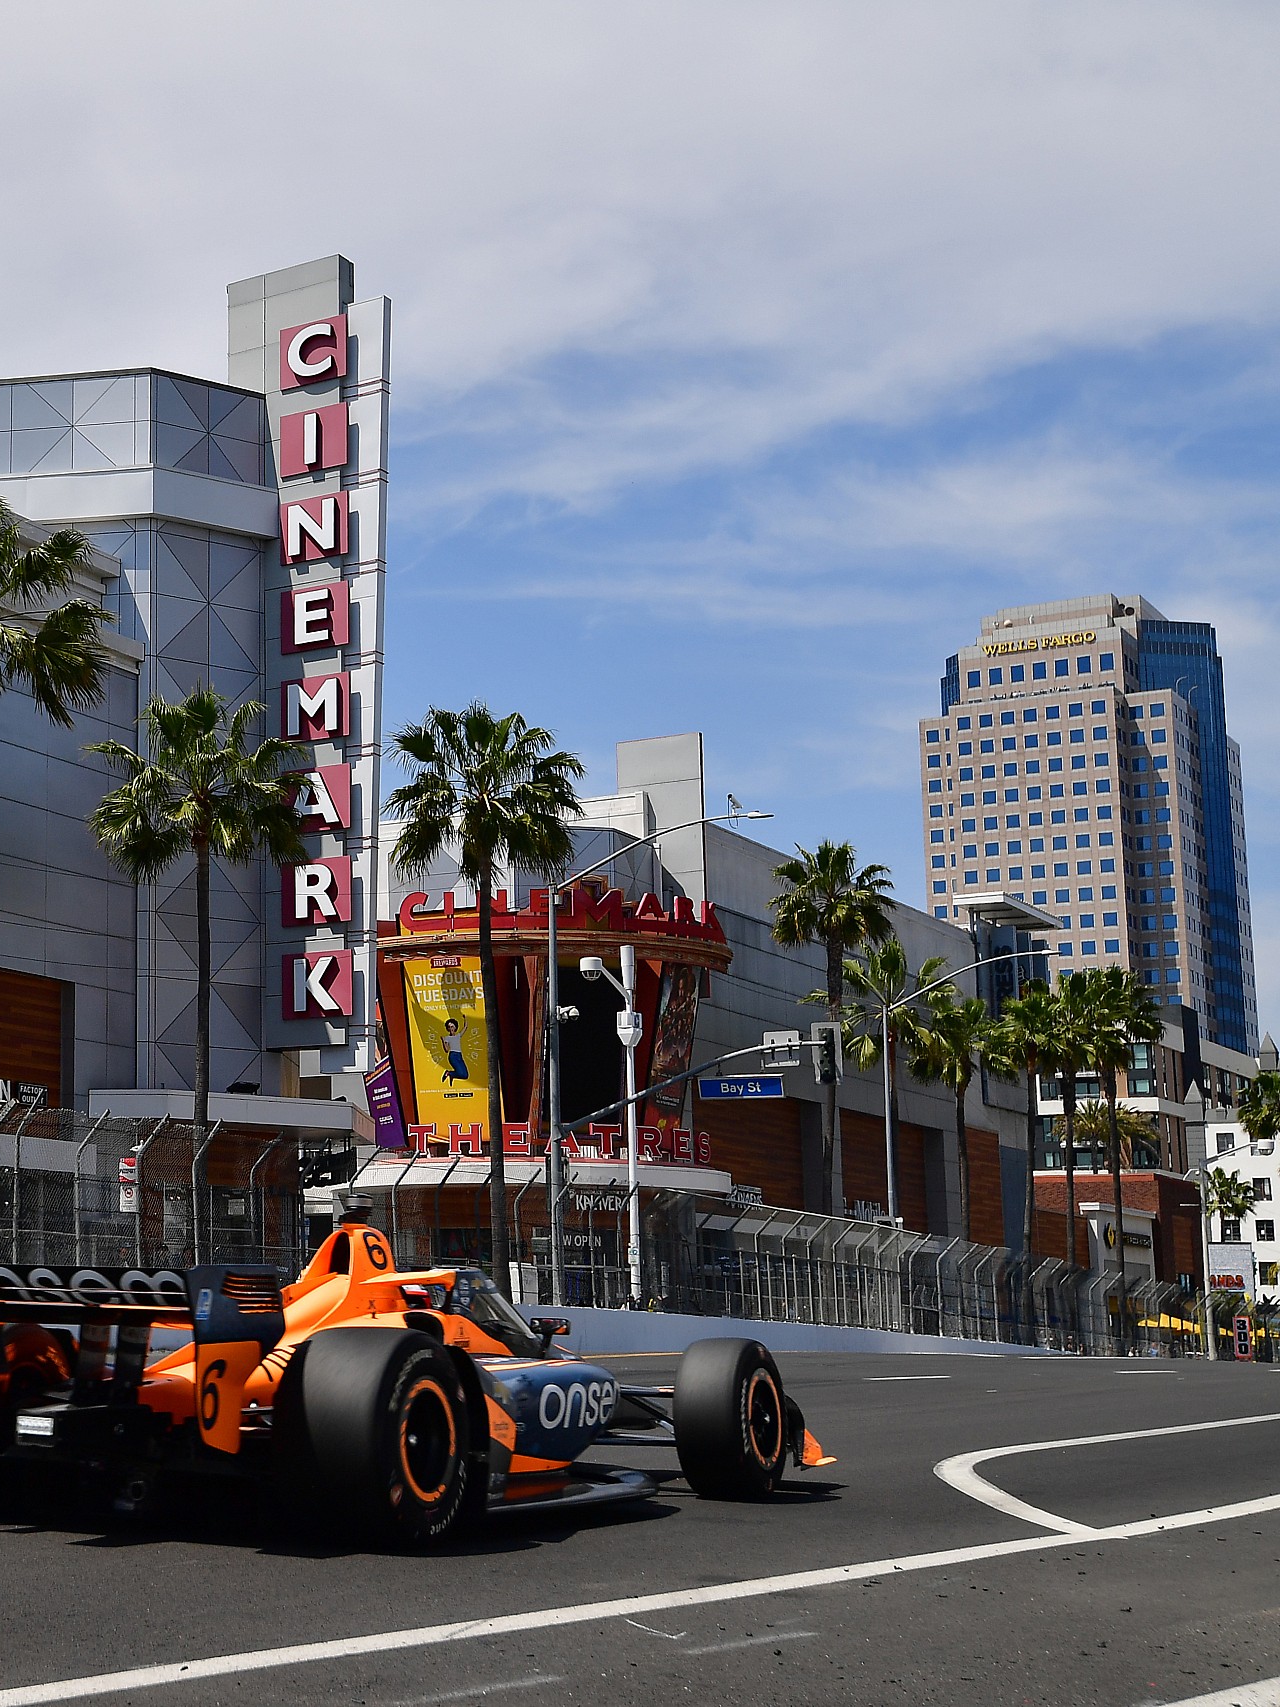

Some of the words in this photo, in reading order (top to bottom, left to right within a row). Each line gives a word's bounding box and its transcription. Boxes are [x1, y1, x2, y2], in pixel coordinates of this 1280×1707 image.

[982, 638, 1037, 657] WELLS
[1041, 630, 1096, 649] FARGO
[286, 322, 341, 1013] CINEMARK
[413, 970, 482, 988] DISCOUNT
[415, 986, 485, 1003] TUESDAYS
[720, 1082, 744, 1096] Bay
[747, 1081, 762, 1093] St
[407, 1122, 712, 1164] THEATRES
[363, 1230, 387, 1271] 6
[201, 1358, 227, 1431] 6
[538, 1380, 619, 1430] onse
